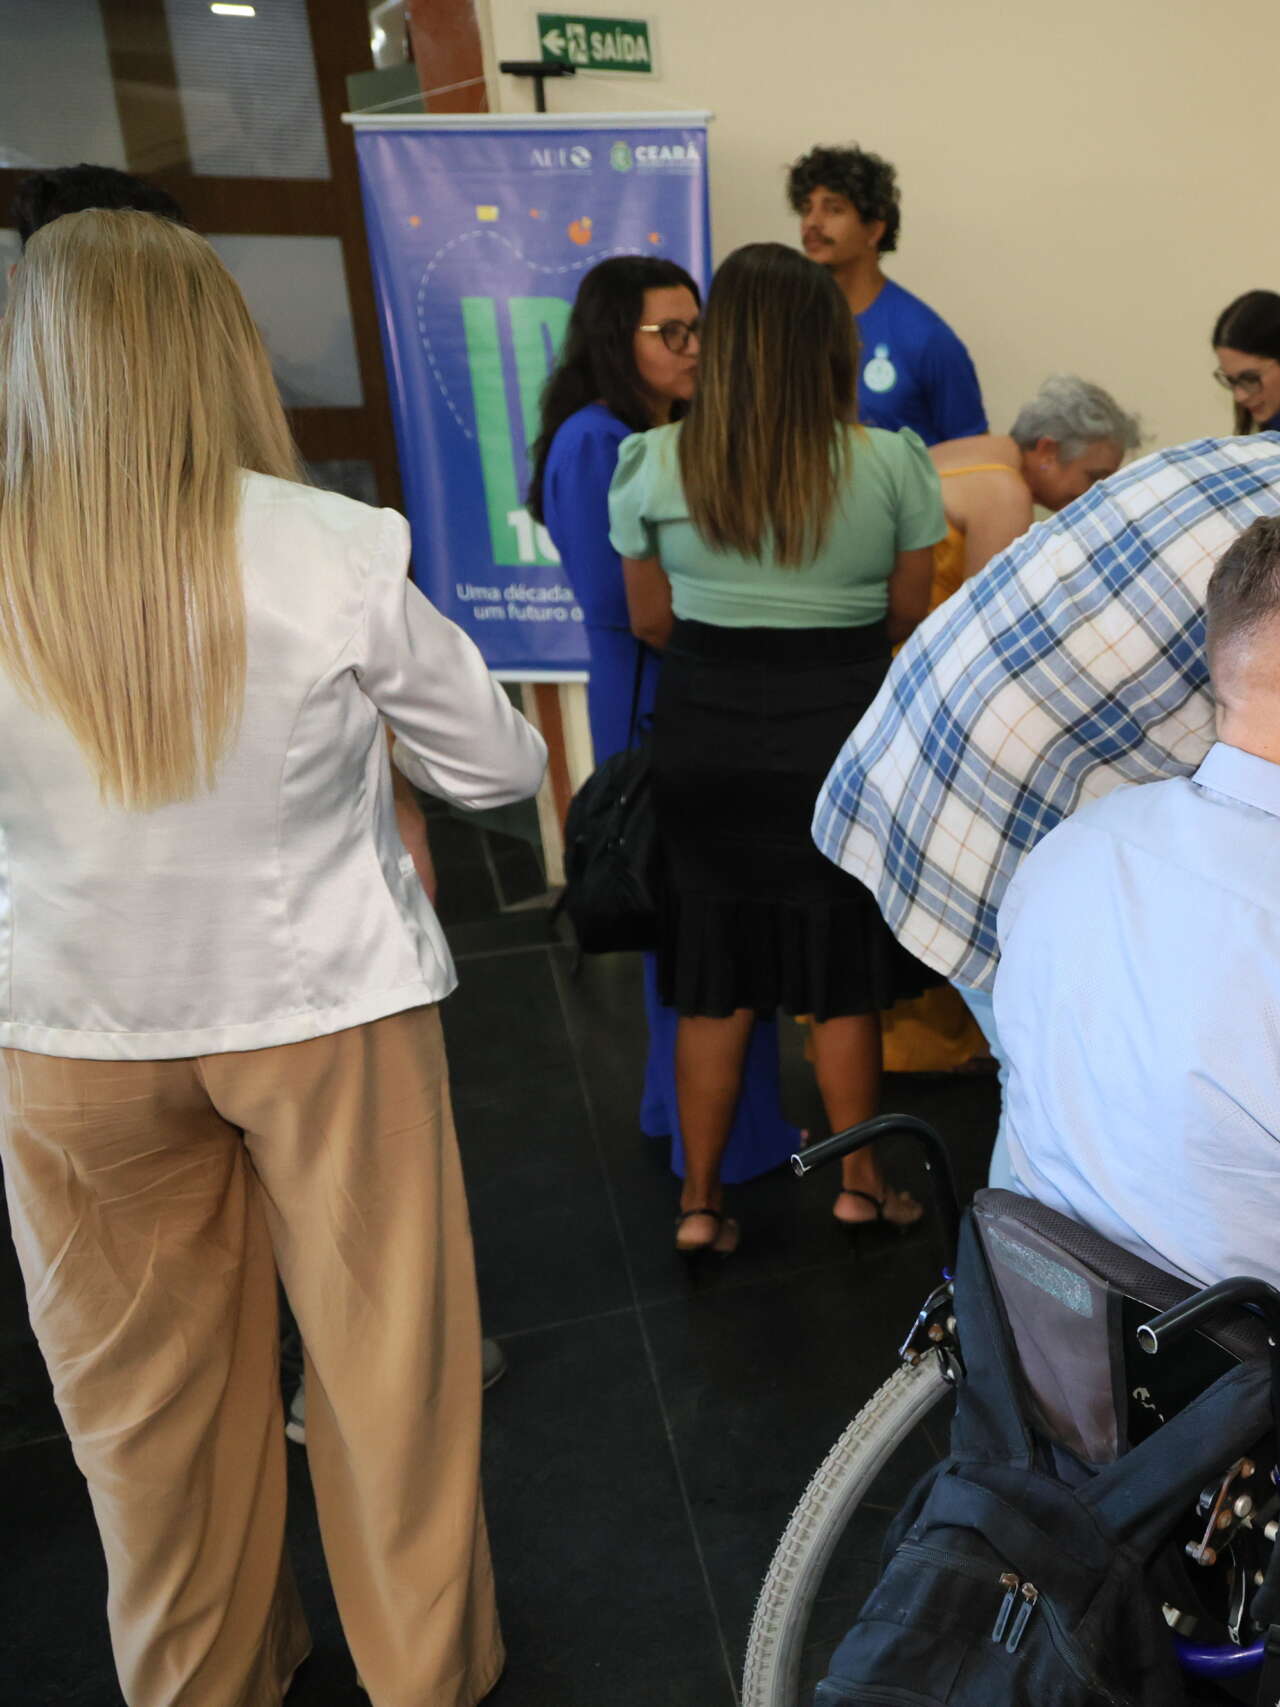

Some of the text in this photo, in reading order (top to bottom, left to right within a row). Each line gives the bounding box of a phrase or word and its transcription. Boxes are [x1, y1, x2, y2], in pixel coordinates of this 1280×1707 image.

[590, 29, 649, 63] SAÍDA
[635, 142, 699, 160] CEARÁ
[456, 583, 574, 603] Uma década
[473, 604, 506, 621] um
[507, 601, 569, 622] futuro
